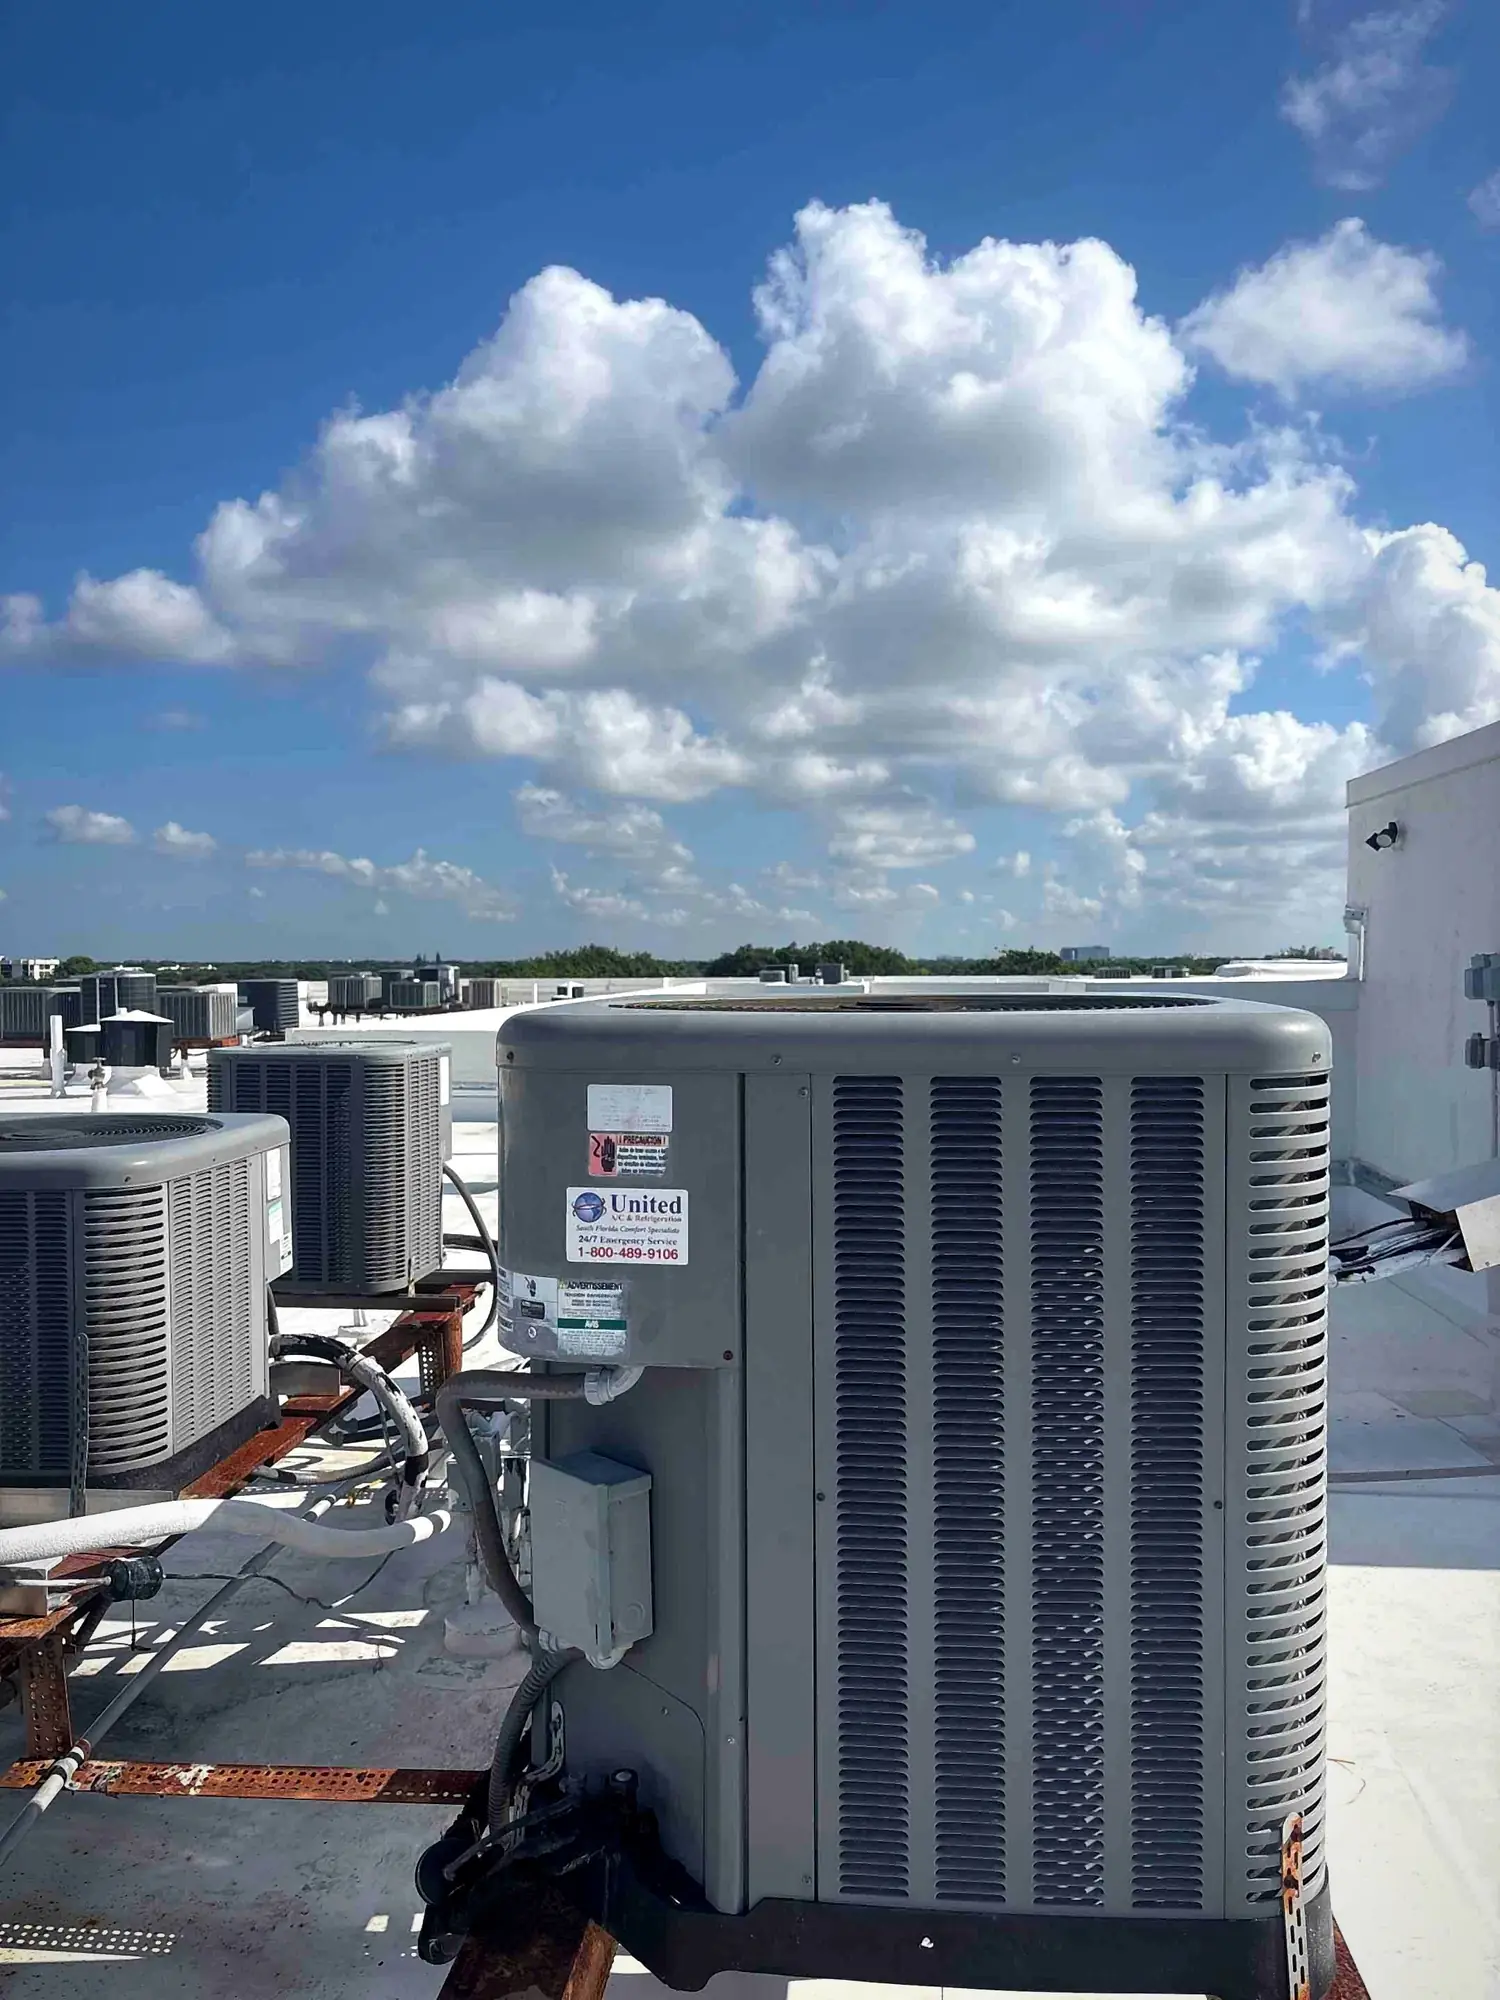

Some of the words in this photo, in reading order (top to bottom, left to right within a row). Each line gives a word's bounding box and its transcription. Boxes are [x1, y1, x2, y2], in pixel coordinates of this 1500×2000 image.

[611, 1194, 682, 1214] United
[635, 1215, 682, 1224] Refrigeration
[576, 1224, 594, 1232] South
[620, 1226, 647, 1234] Comfort
[648, 1226, 680, 1234] Specialists
[578, 1235, 597, 1243] 24/7
[600, 1236, 645, 1246] Emergency
[647, 1237, 677, 1246] Service
[578, 1246, 679, 1260] 1-800-489-9106
